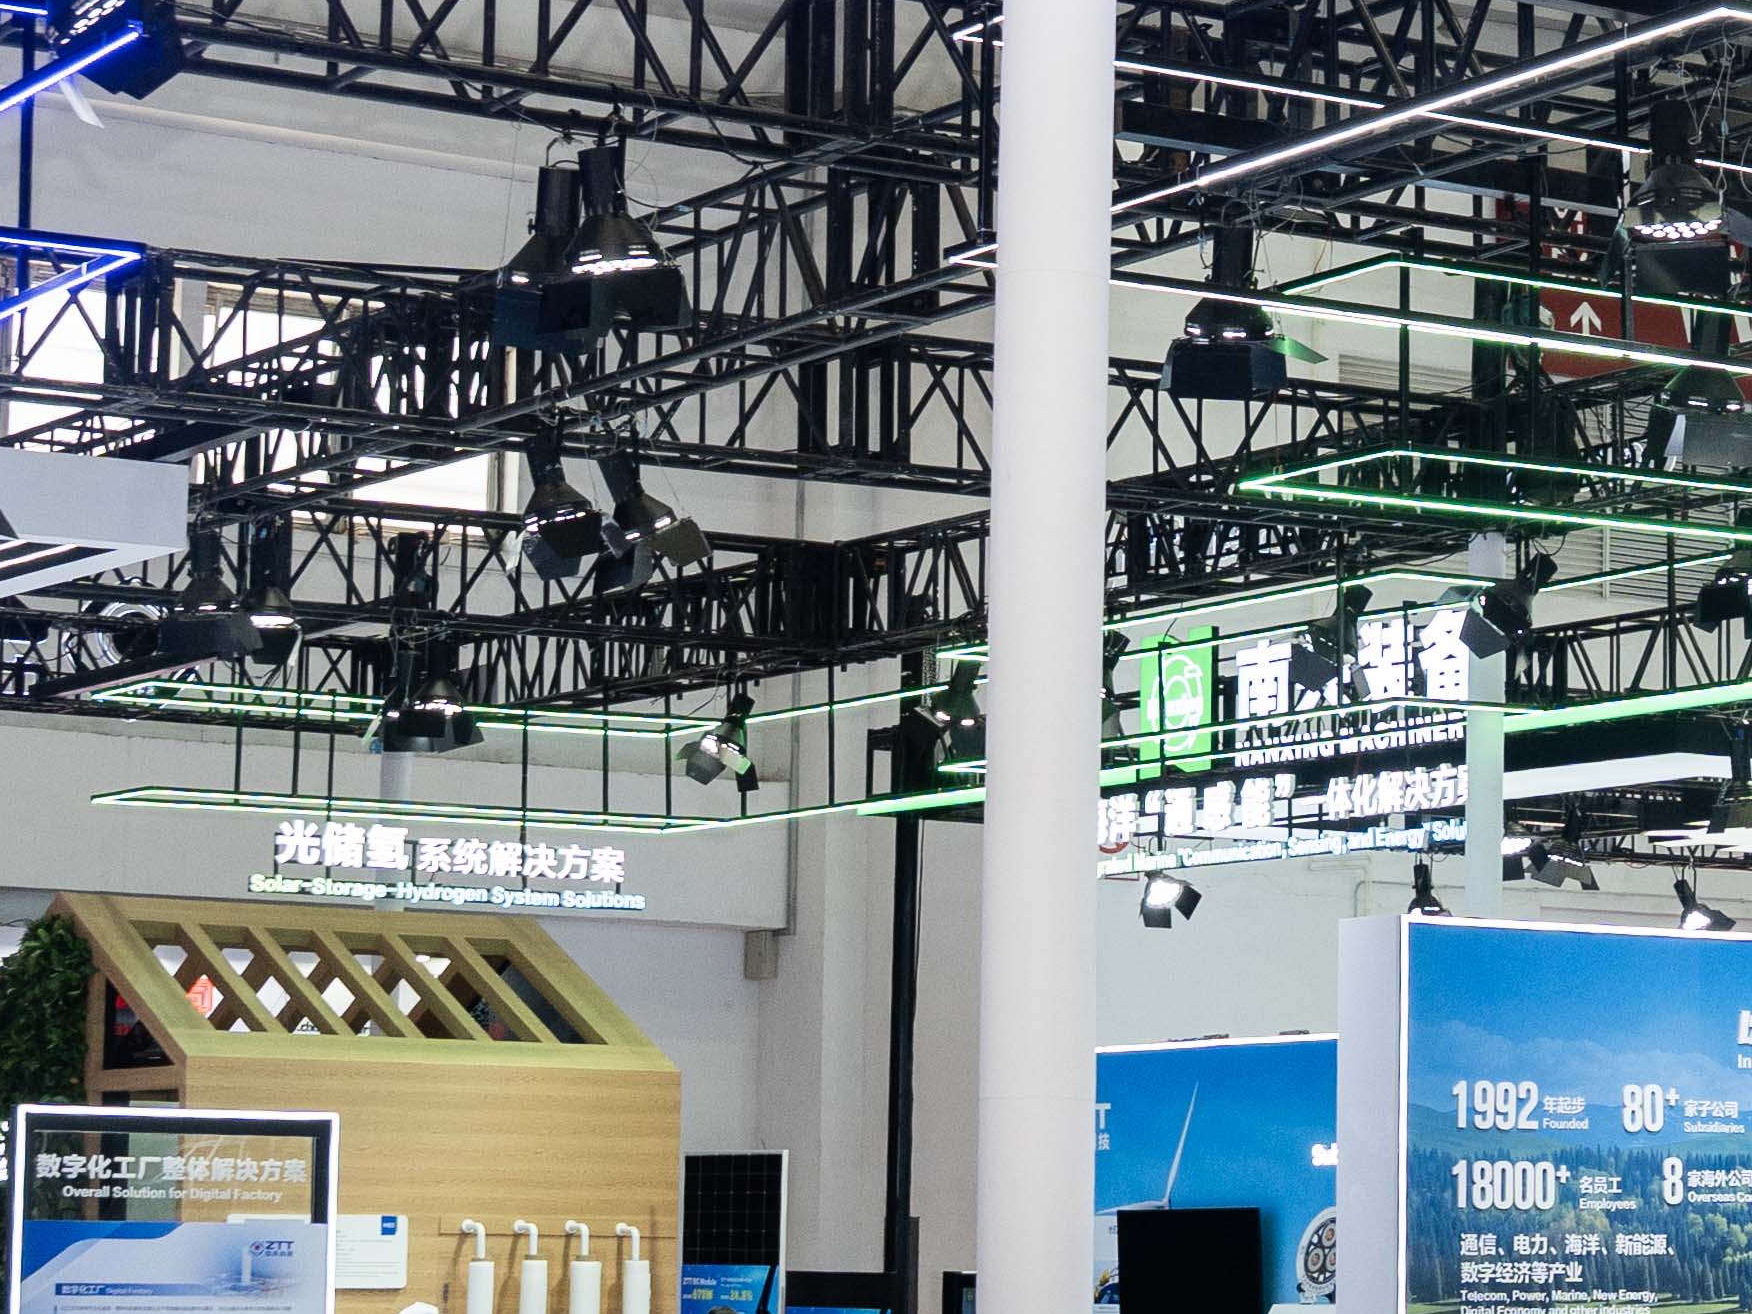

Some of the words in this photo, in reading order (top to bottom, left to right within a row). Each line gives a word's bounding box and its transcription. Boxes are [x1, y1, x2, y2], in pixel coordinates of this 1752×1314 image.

[1236, 608, 1470, 719] 南装备
[275, 819, 410, 871] 光储氢
[416, 837, 625, 883] 系统解决方案
[249, 873, 489, 905] Solar-Storage-Hydrogen
[491, 885, 560, 909] System
[562, 890, 646, 912] Solutions
[1451, 1080, 1539, 1131] 1992
[1543, 1095, 1586, 1116] 年起步
[1622, 1083, 1680, 1134] 80+
[1683, 1099, 1739, 1119] 家子公司
[1543, 1118, 1589, 1131] Founded
[1683, 1120, 1746, 1135] Subsidiaries
[35, 1153, 307, 1183] 数字化工厂整体解决方案
[1451, 1159, 1571, 1211] 18000+
[1578, 1176, 1623, 1195] 名员工
[1662, 1157, 1684, 1206] 8
[62, 1185, 110, 1199] Overall
[112, 1186, 166, 1200] Solution
[168, 1187, 187, 1201] for
[189, 1188, 231, 1203] Digital
[234, 1189, 282, 1204] Factory
[1579, 1198, 1637, 1213] Employees
[1687, 1191, 1735, 1204] Overseas
[264, 1240, 295, 1252] ZTT
[1460, 1233, 1675, 1258] 通信、电力、海洋、新能源、
[1460, 1261, 1584, 1285] 数字经济等产业
[1460, 1289, 1510, 1304] Telecom,
[1512, 1289, 1549, 1303] Power,
[1551, 1289, 1591, 1303] Marine,
[1593, 1289, 1617, 1302] New
[1618, 1289, 1659, 1305] Energy,
